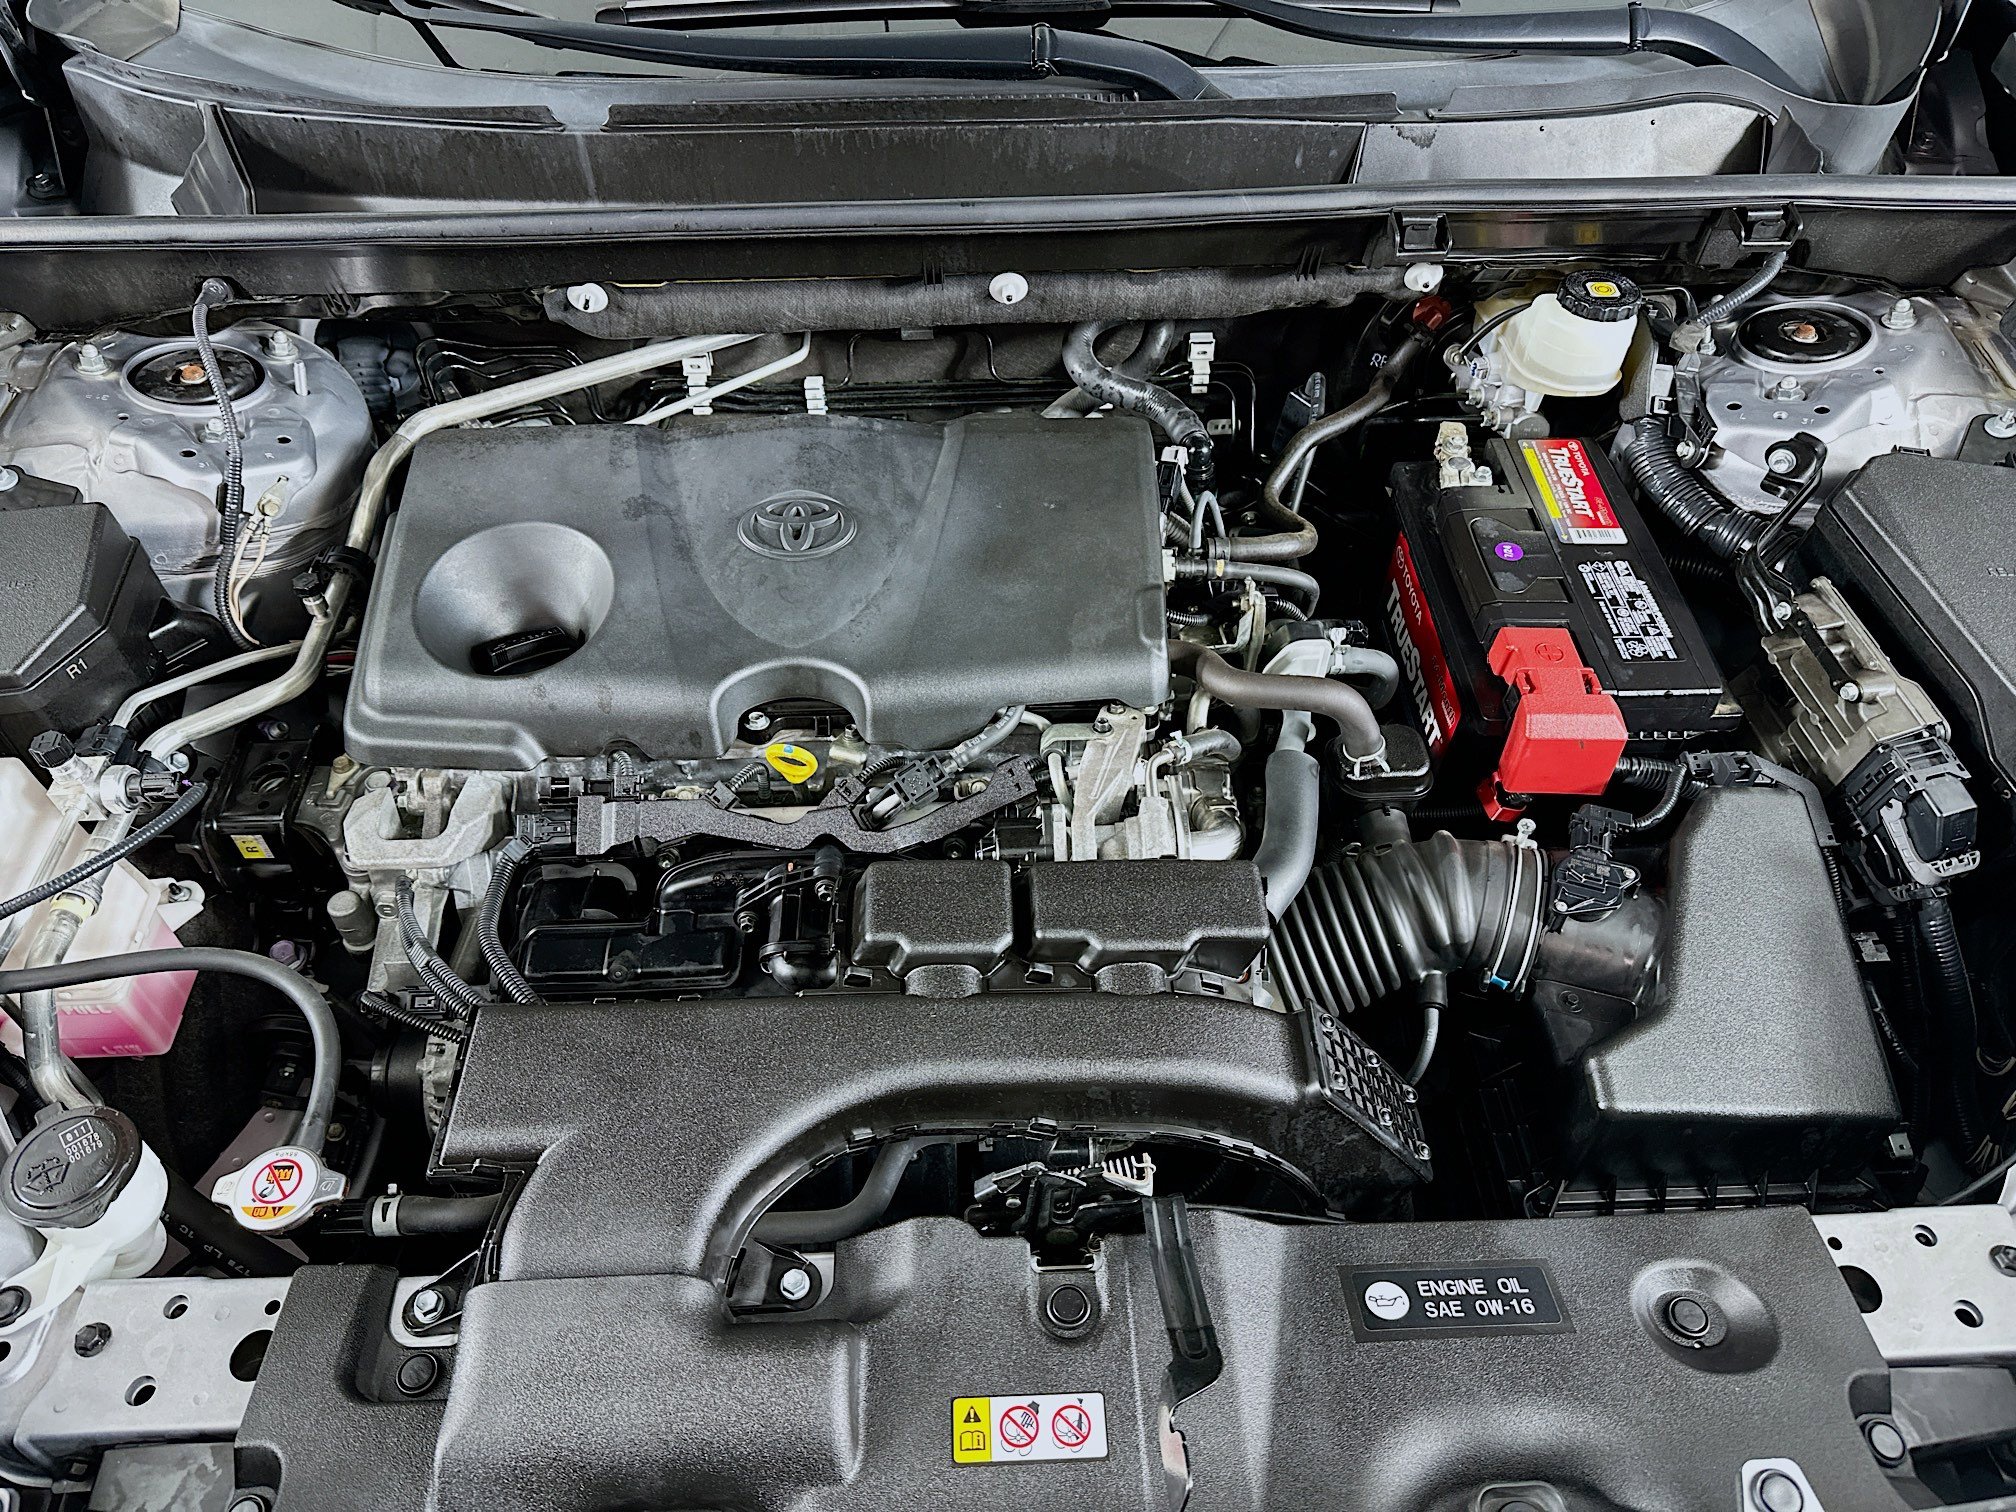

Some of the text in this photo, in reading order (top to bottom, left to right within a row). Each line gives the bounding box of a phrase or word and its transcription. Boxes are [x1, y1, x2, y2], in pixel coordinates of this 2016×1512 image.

[1574, 451, 1590, 477] TOYOTA
[1402, 564, 1423, 626] TOYOTA
[65, 657, 88, 680] R1
[1386, 578, 1442, 747] TRUESTART
[65, 1132, 100, 1156] 001678
[69, 1139, 103, 1164] 001679
[203, 1244, 224, 1259] LP
[1416, 1277, 1529, 1297] ENGINE OIL
[1424, 1298, 1536, 1318] SAE 0W-16
